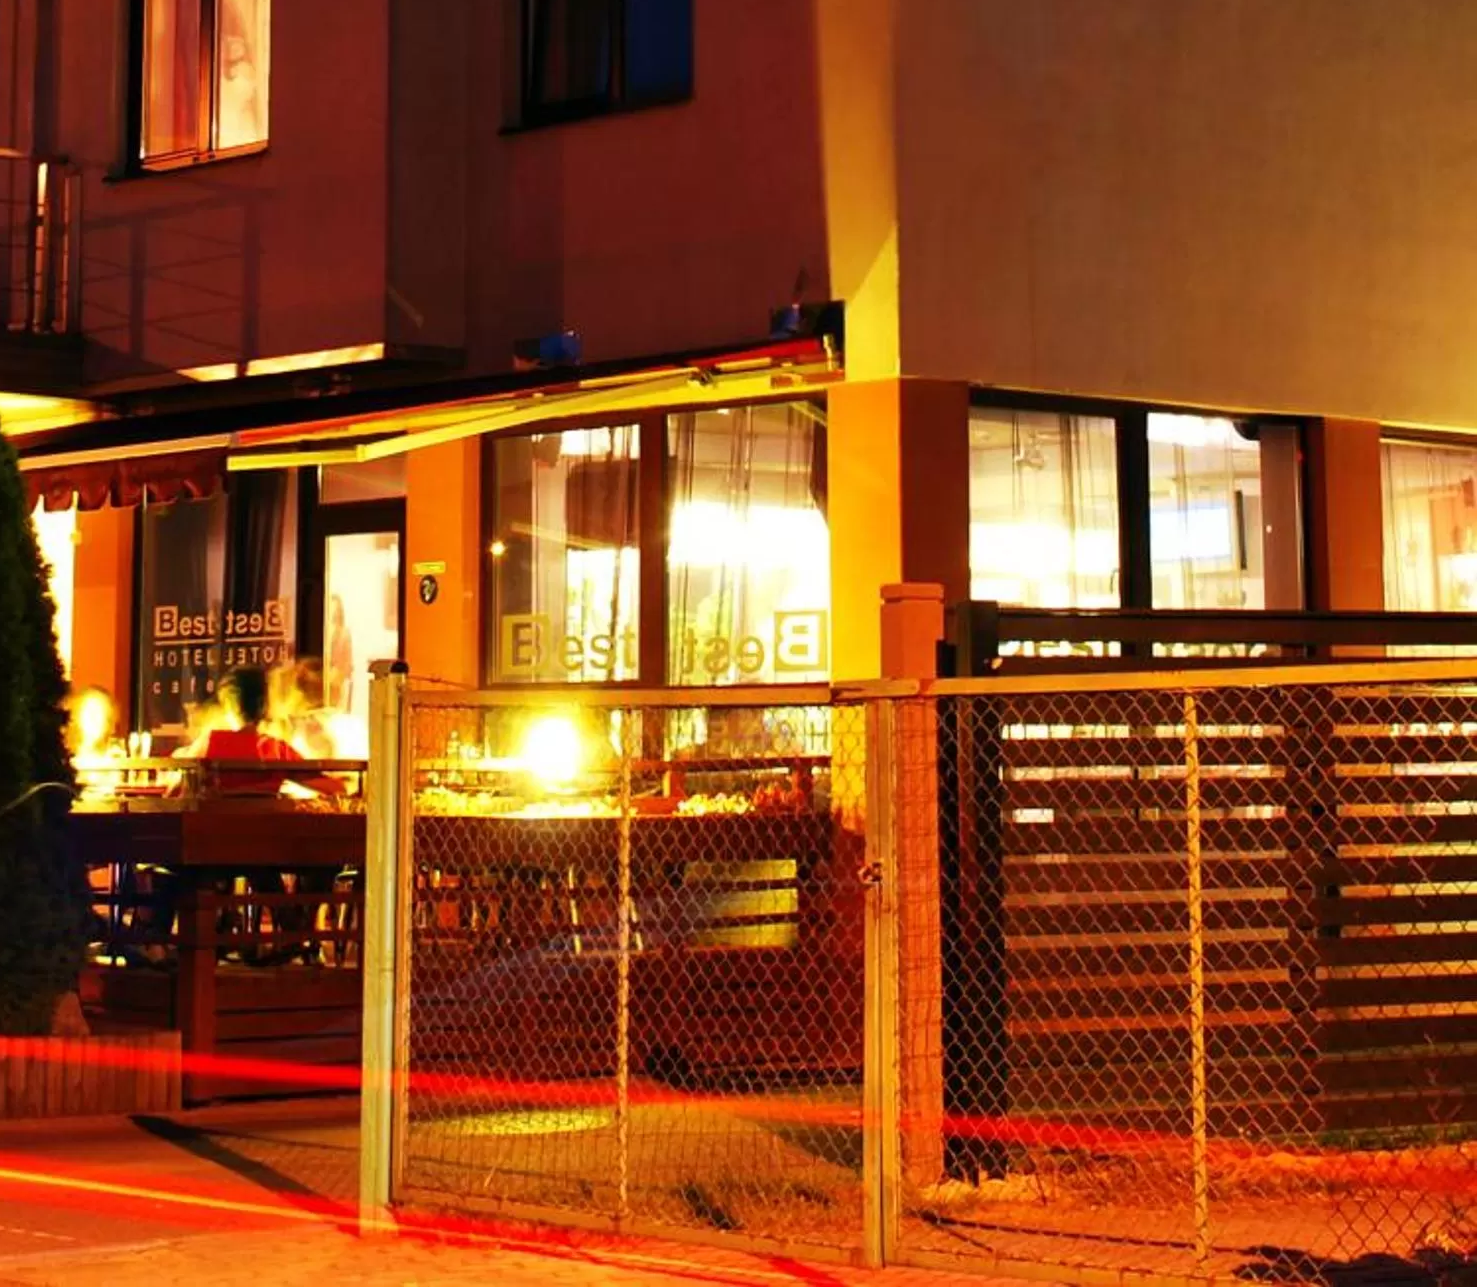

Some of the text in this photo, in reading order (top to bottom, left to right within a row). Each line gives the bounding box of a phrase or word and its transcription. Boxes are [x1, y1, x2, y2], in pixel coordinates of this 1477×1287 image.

[155, 605, 216, 636] Best
[153, 648, 216, 667] HOTEL
[503, 615, 638, 674] Best
